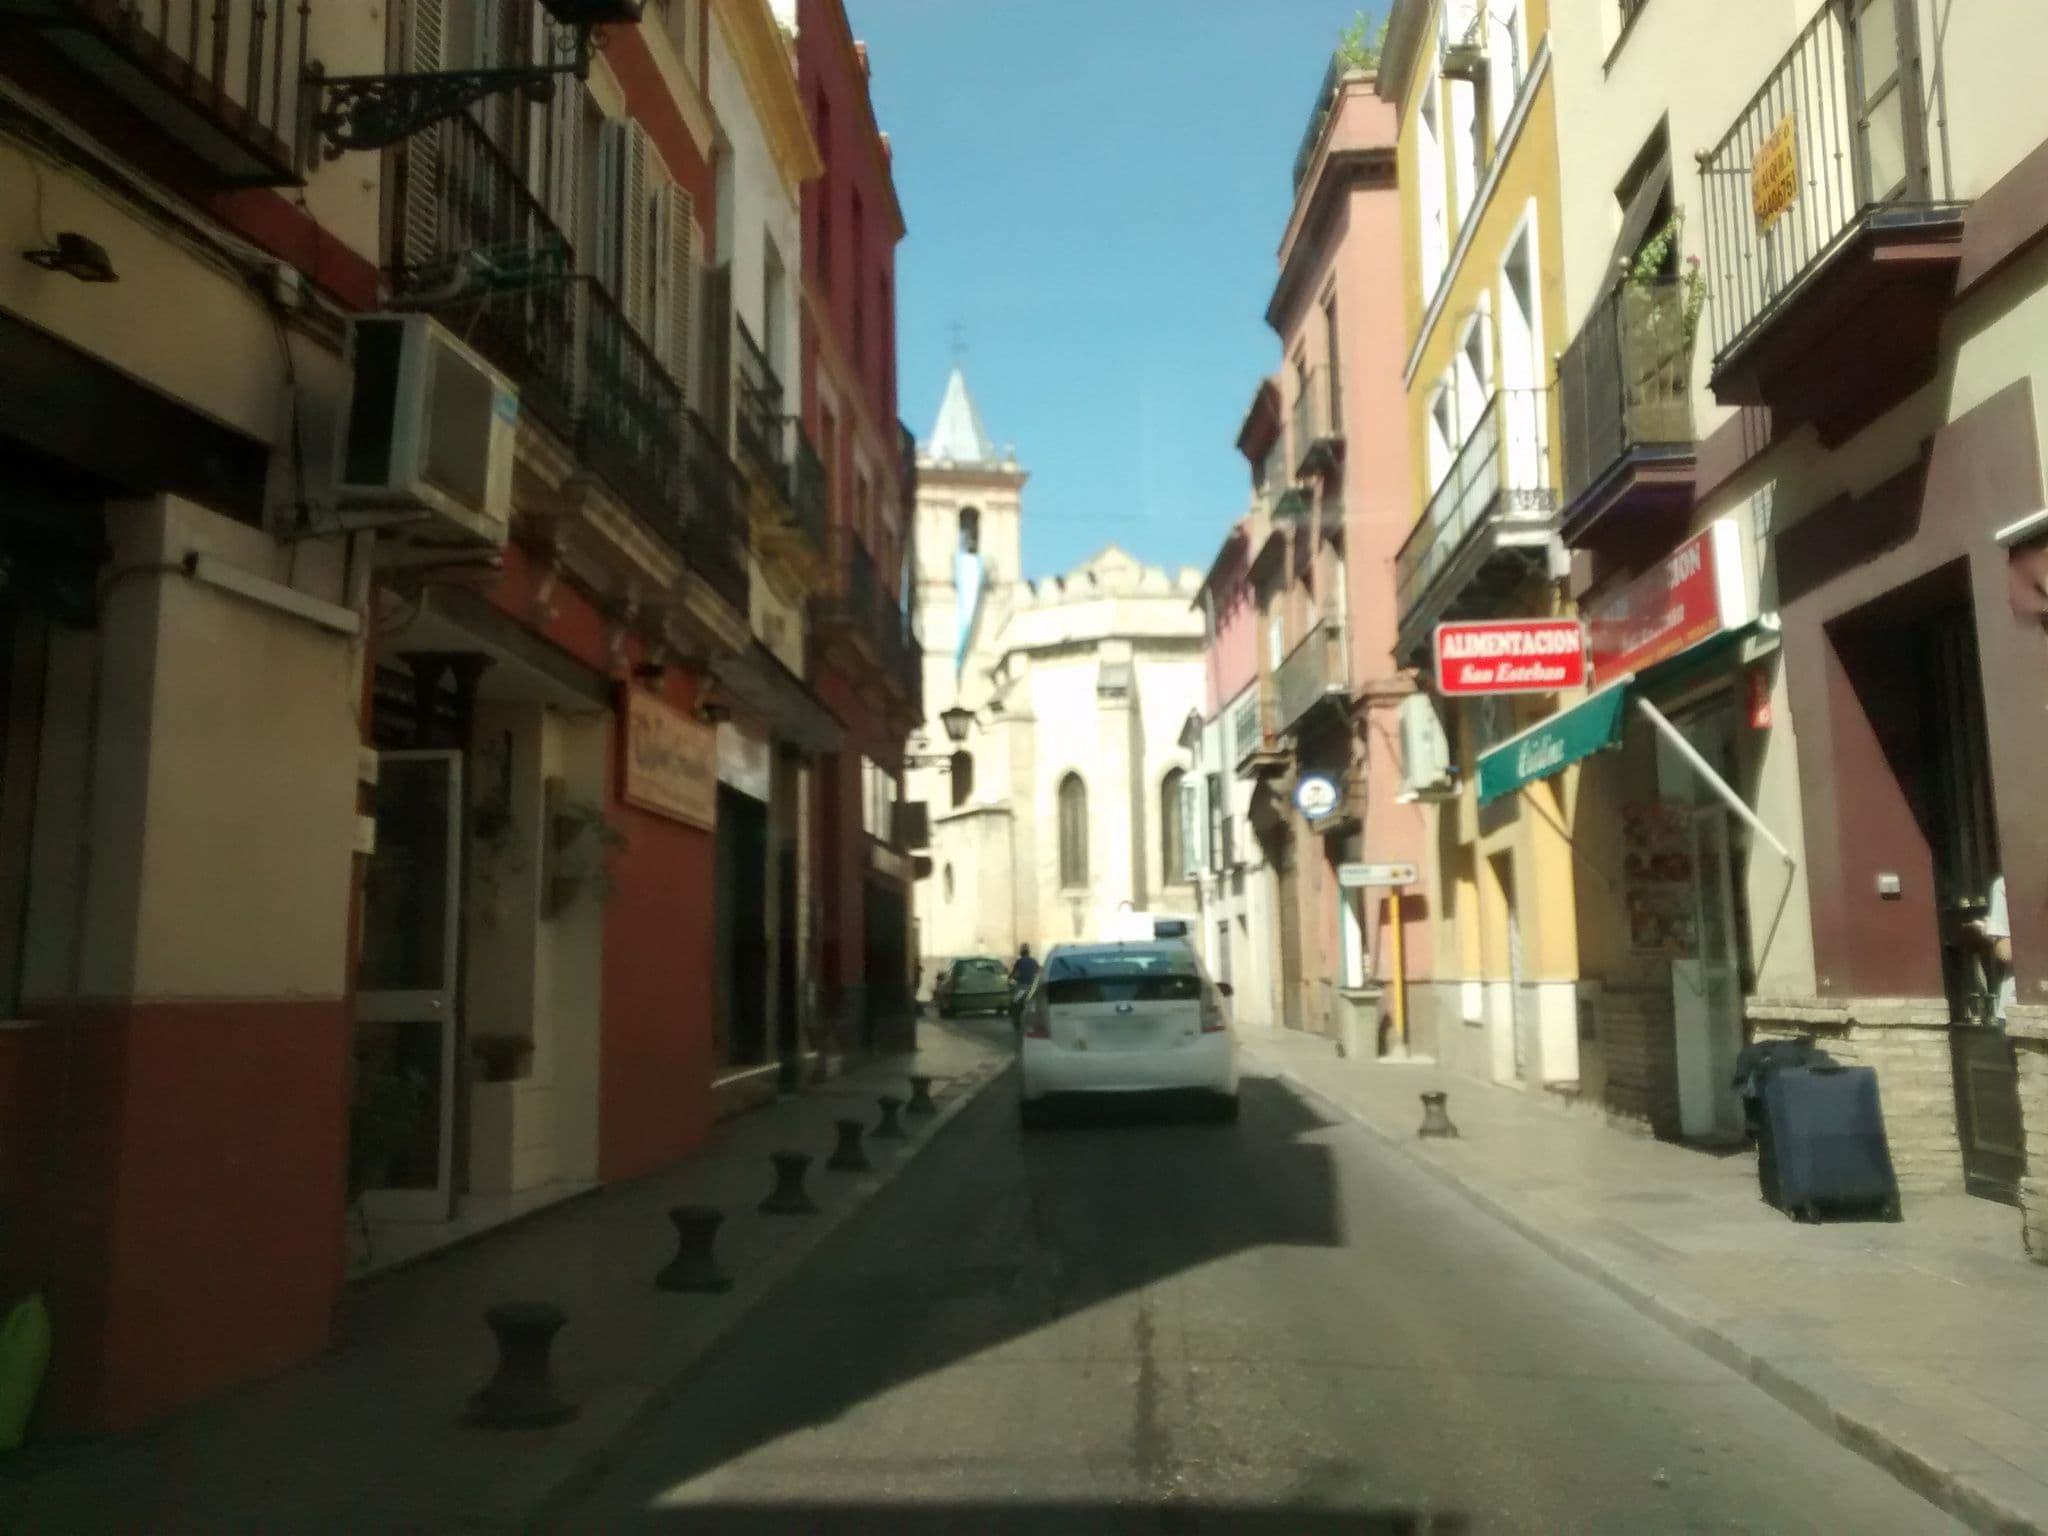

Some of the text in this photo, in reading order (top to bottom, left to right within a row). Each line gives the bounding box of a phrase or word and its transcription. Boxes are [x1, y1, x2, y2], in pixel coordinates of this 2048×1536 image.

[1442, 630, 1580, 658] ALIMENTACION
[1459, 661, 1567, 684] San Esteban
